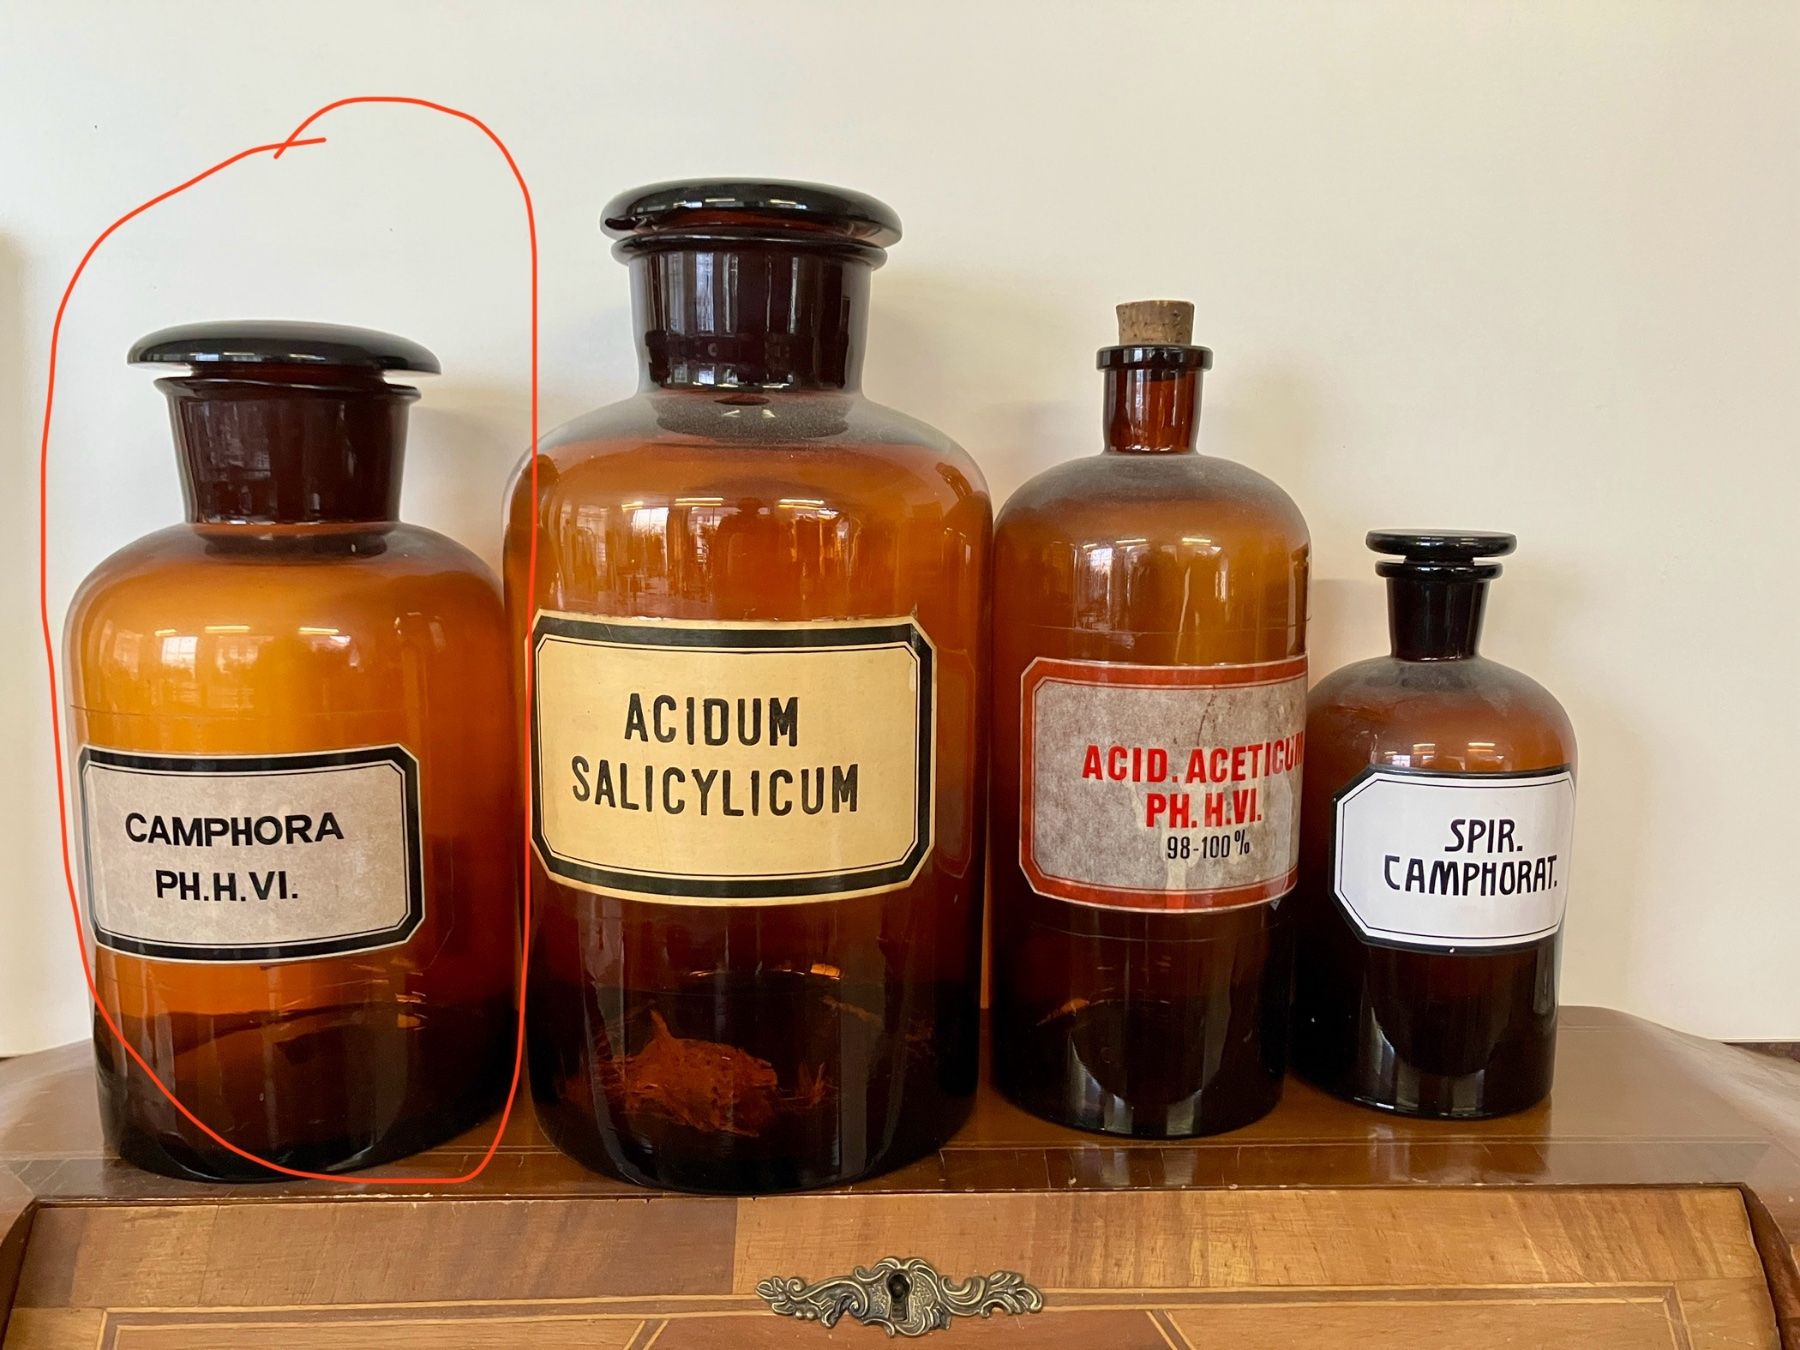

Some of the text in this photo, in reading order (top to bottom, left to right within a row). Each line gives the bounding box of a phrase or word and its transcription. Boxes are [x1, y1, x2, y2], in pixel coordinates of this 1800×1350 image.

[624, 693, 798, 746] ACIDUM
[571, 756, 858, 816] SALICYLICUM
[125, 812, 344, 847] CAMPHORA
[1444, 819, 1523, 853] SPIR.
[1384, 855, 1558, 896] CAMPHORAT.
